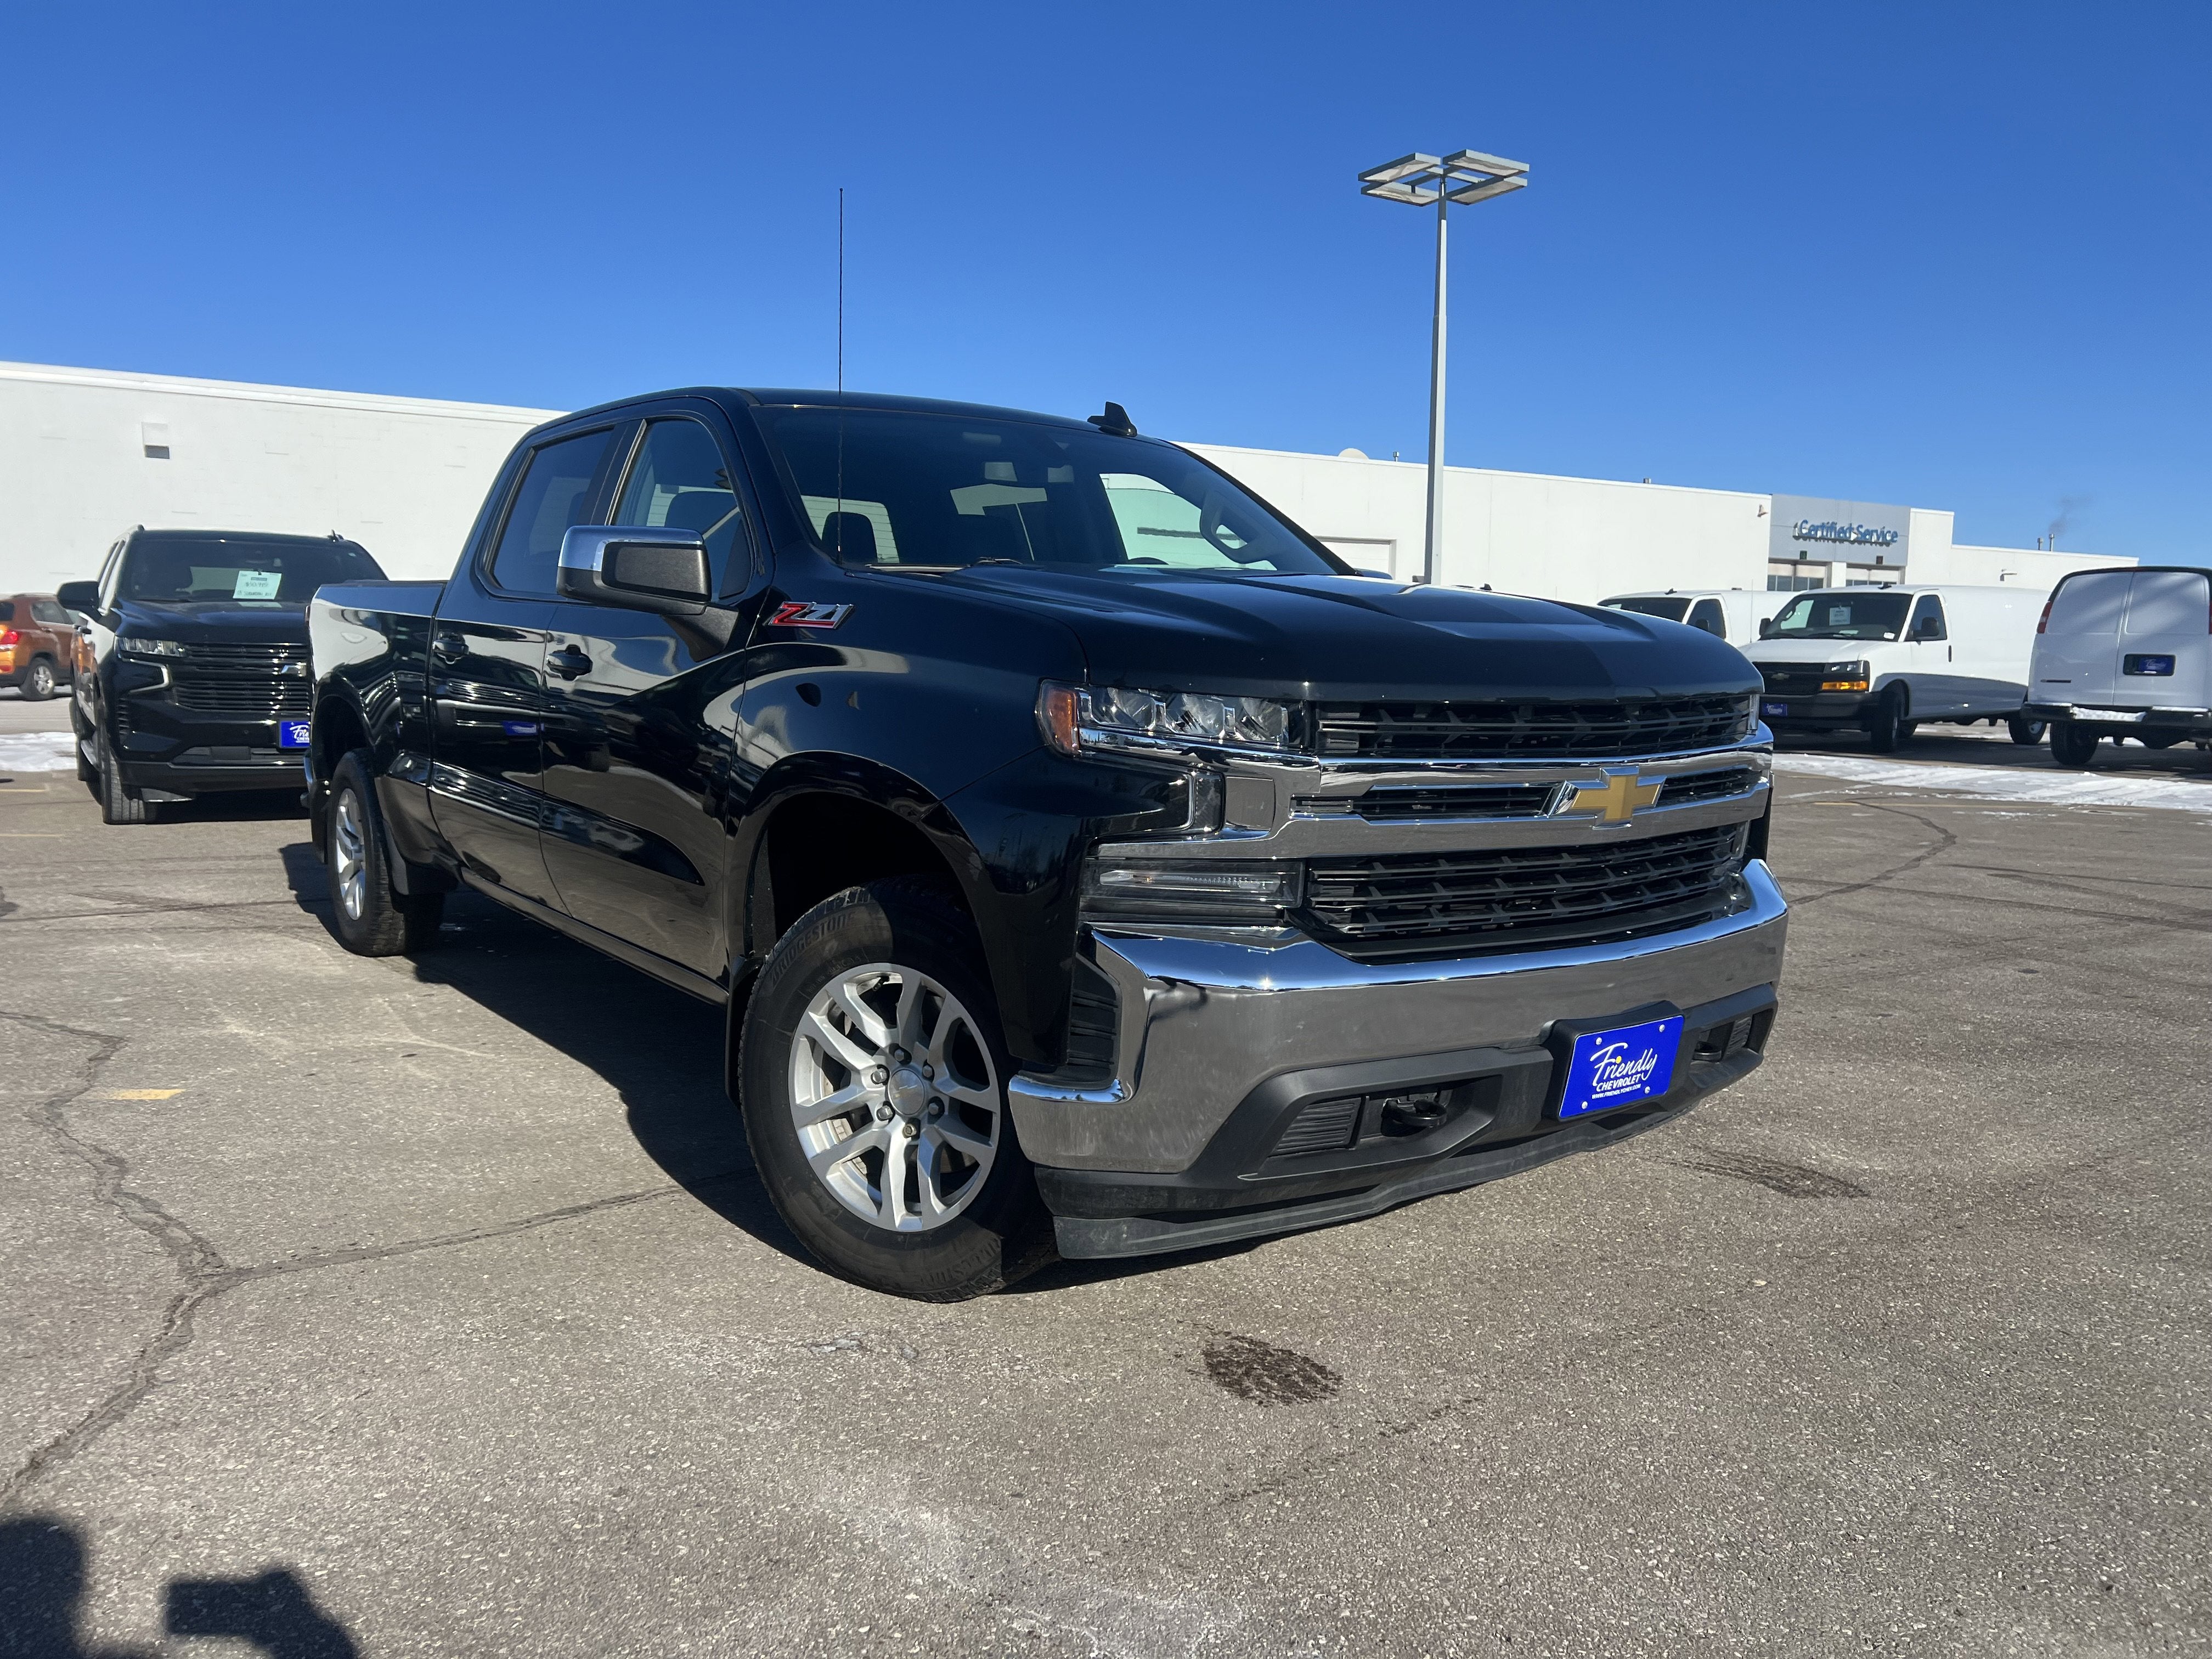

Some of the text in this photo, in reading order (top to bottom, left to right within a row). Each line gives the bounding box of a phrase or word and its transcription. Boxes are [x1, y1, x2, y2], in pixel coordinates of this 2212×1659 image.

[1799, 519, 1898, 543] Certified Service
[768, 601, 855, 629] Z71
[1589, 1042, 1658, 1086] Friendly
[1596, 1074, 1641, 1092] CHEVROLET
